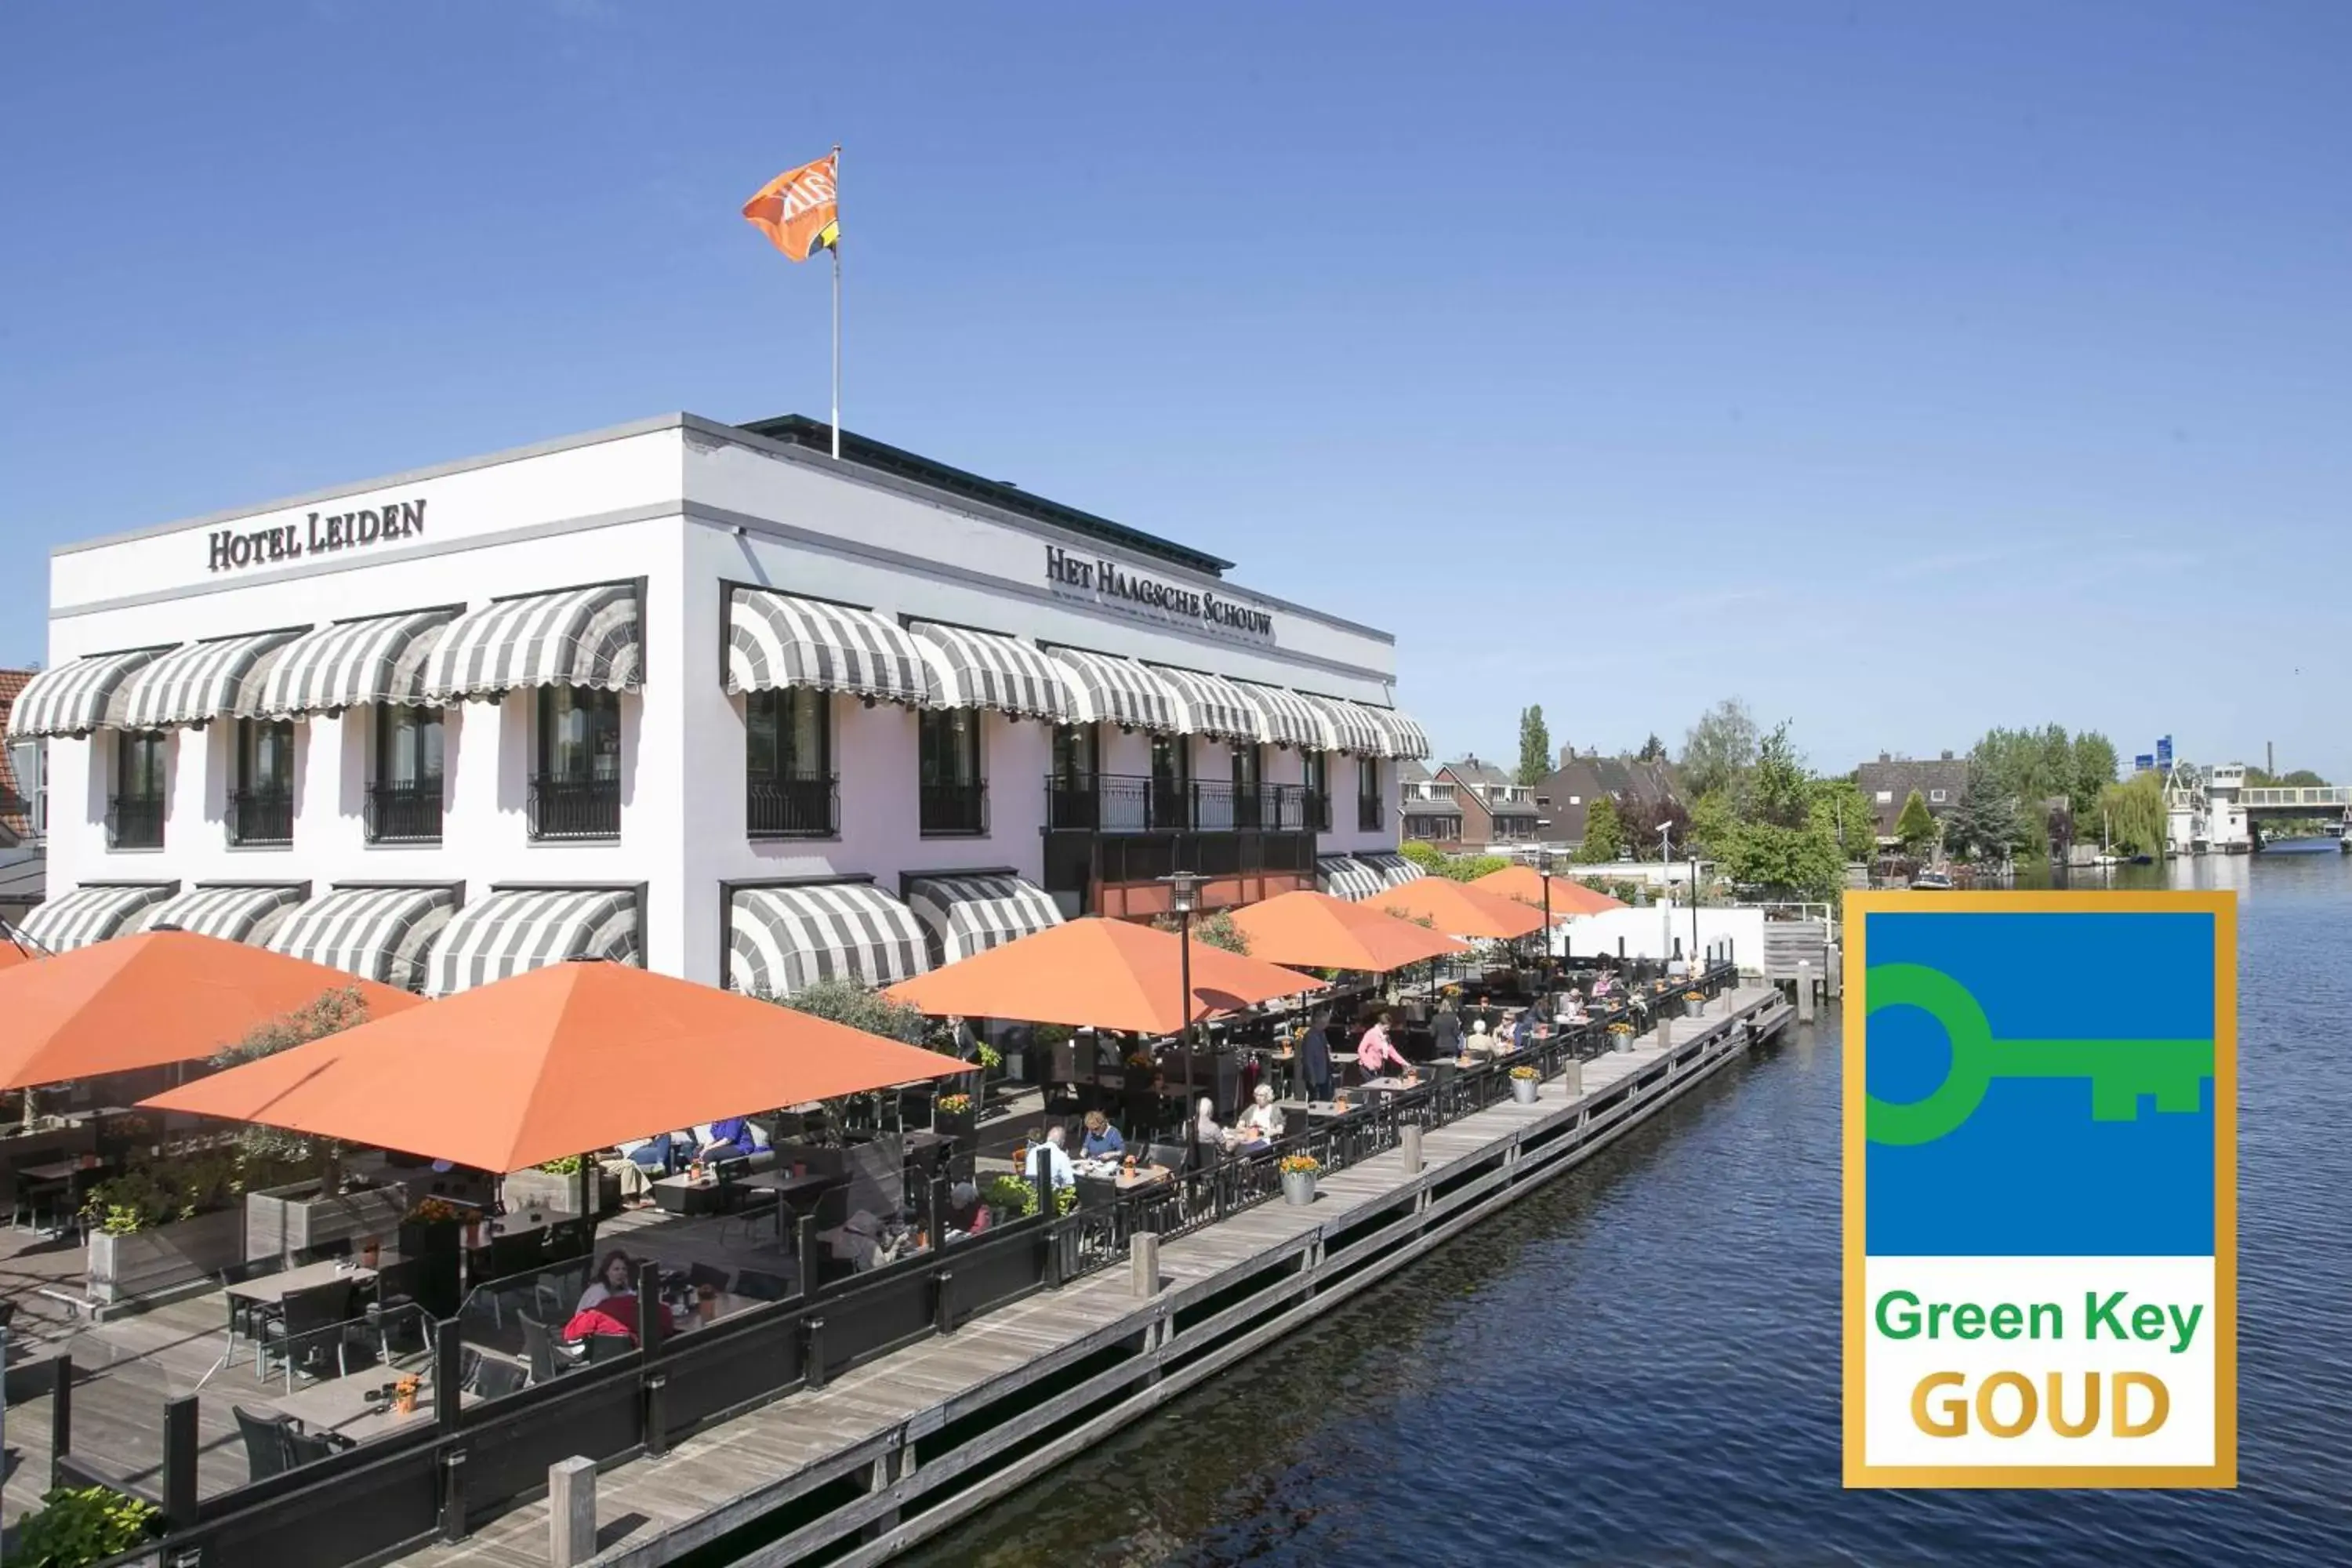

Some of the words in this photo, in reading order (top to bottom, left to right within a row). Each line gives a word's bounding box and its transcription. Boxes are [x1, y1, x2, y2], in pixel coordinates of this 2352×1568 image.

[208, 525, 301, 572] HOTEL
[307, 499, 426, 554] LEIDEN
[1045, 545, 1094, 588] HET
[1096, 560, 1200, 617] HAAGSCHE
[1203, 592, 1272, 636] SCHOUW
